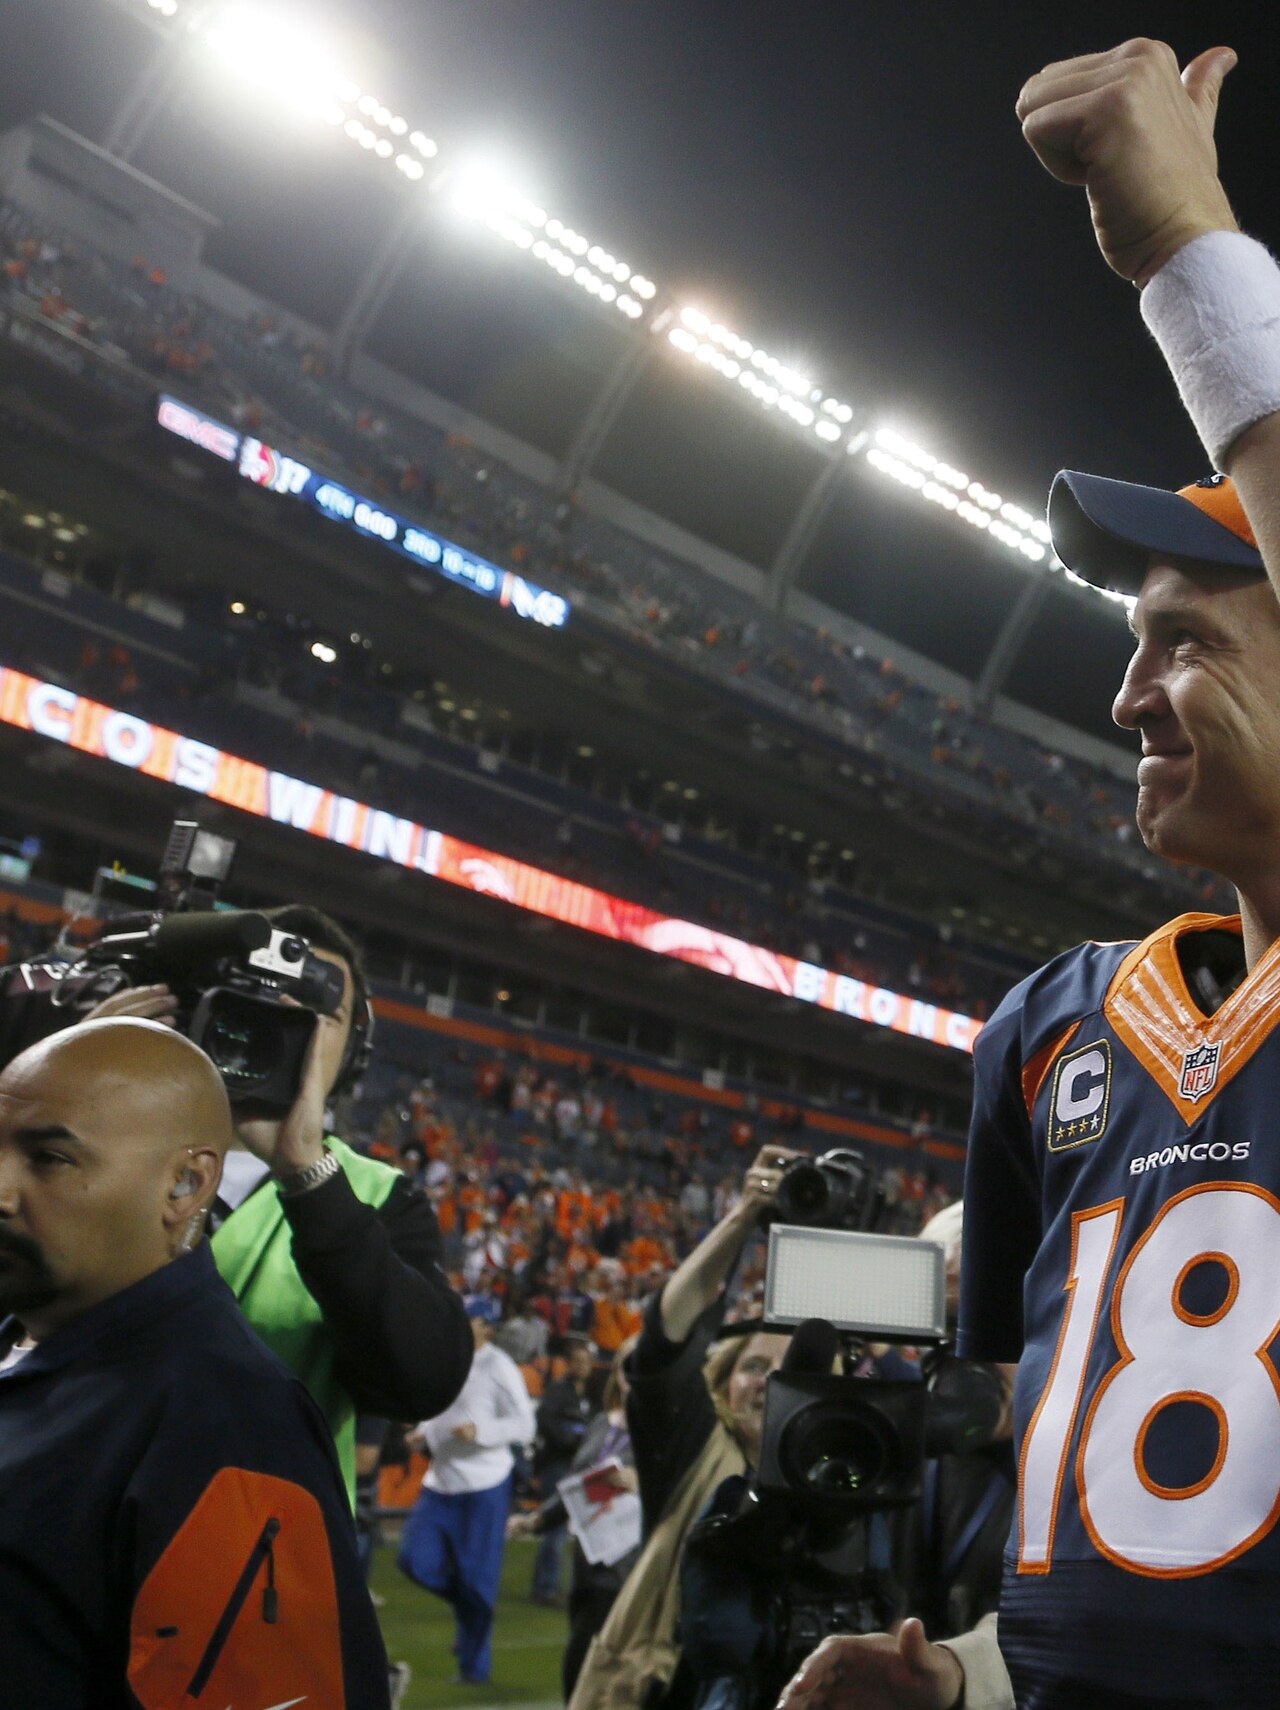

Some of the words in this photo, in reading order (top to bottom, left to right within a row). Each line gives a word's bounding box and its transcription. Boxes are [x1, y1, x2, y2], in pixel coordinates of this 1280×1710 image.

[27, 683, 221, 794] COS
[267, 770, 443, 876] WIN!
[793, 960, 972, 1051] BRONC
[1056, 1050, 1106, 1122] C
[1184, 1066, 1212, 1092] NFL
[1130, 1142, 1251, 1176] BRONCOS
